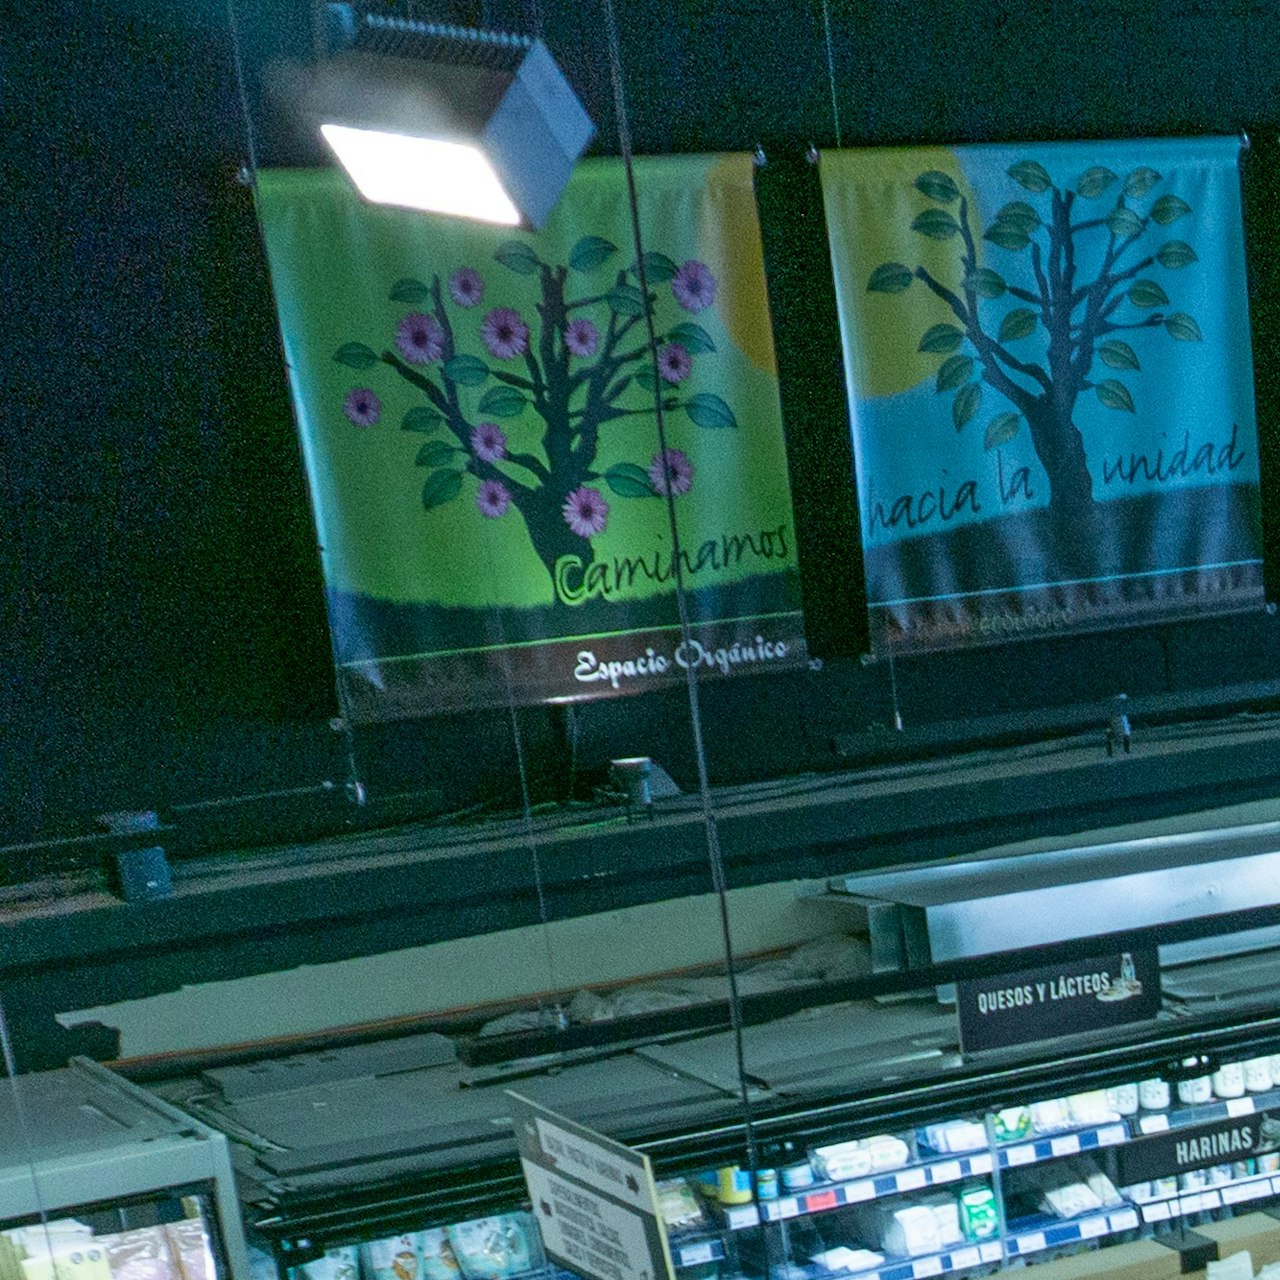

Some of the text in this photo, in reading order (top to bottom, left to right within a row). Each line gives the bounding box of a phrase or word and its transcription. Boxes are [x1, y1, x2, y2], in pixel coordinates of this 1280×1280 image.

[1103, 423, 1245, 485] unidad
[869, 447, 1035, 536] hacia la
[557, 525, 788, 600] Caminamos
[574, 635, 786, 688] Espacio Orgánico
[977, 970, 1111, 1014] QUESOS Y LÁCTEOS
[1175, 1125, 1254, 1165] HARINAS
